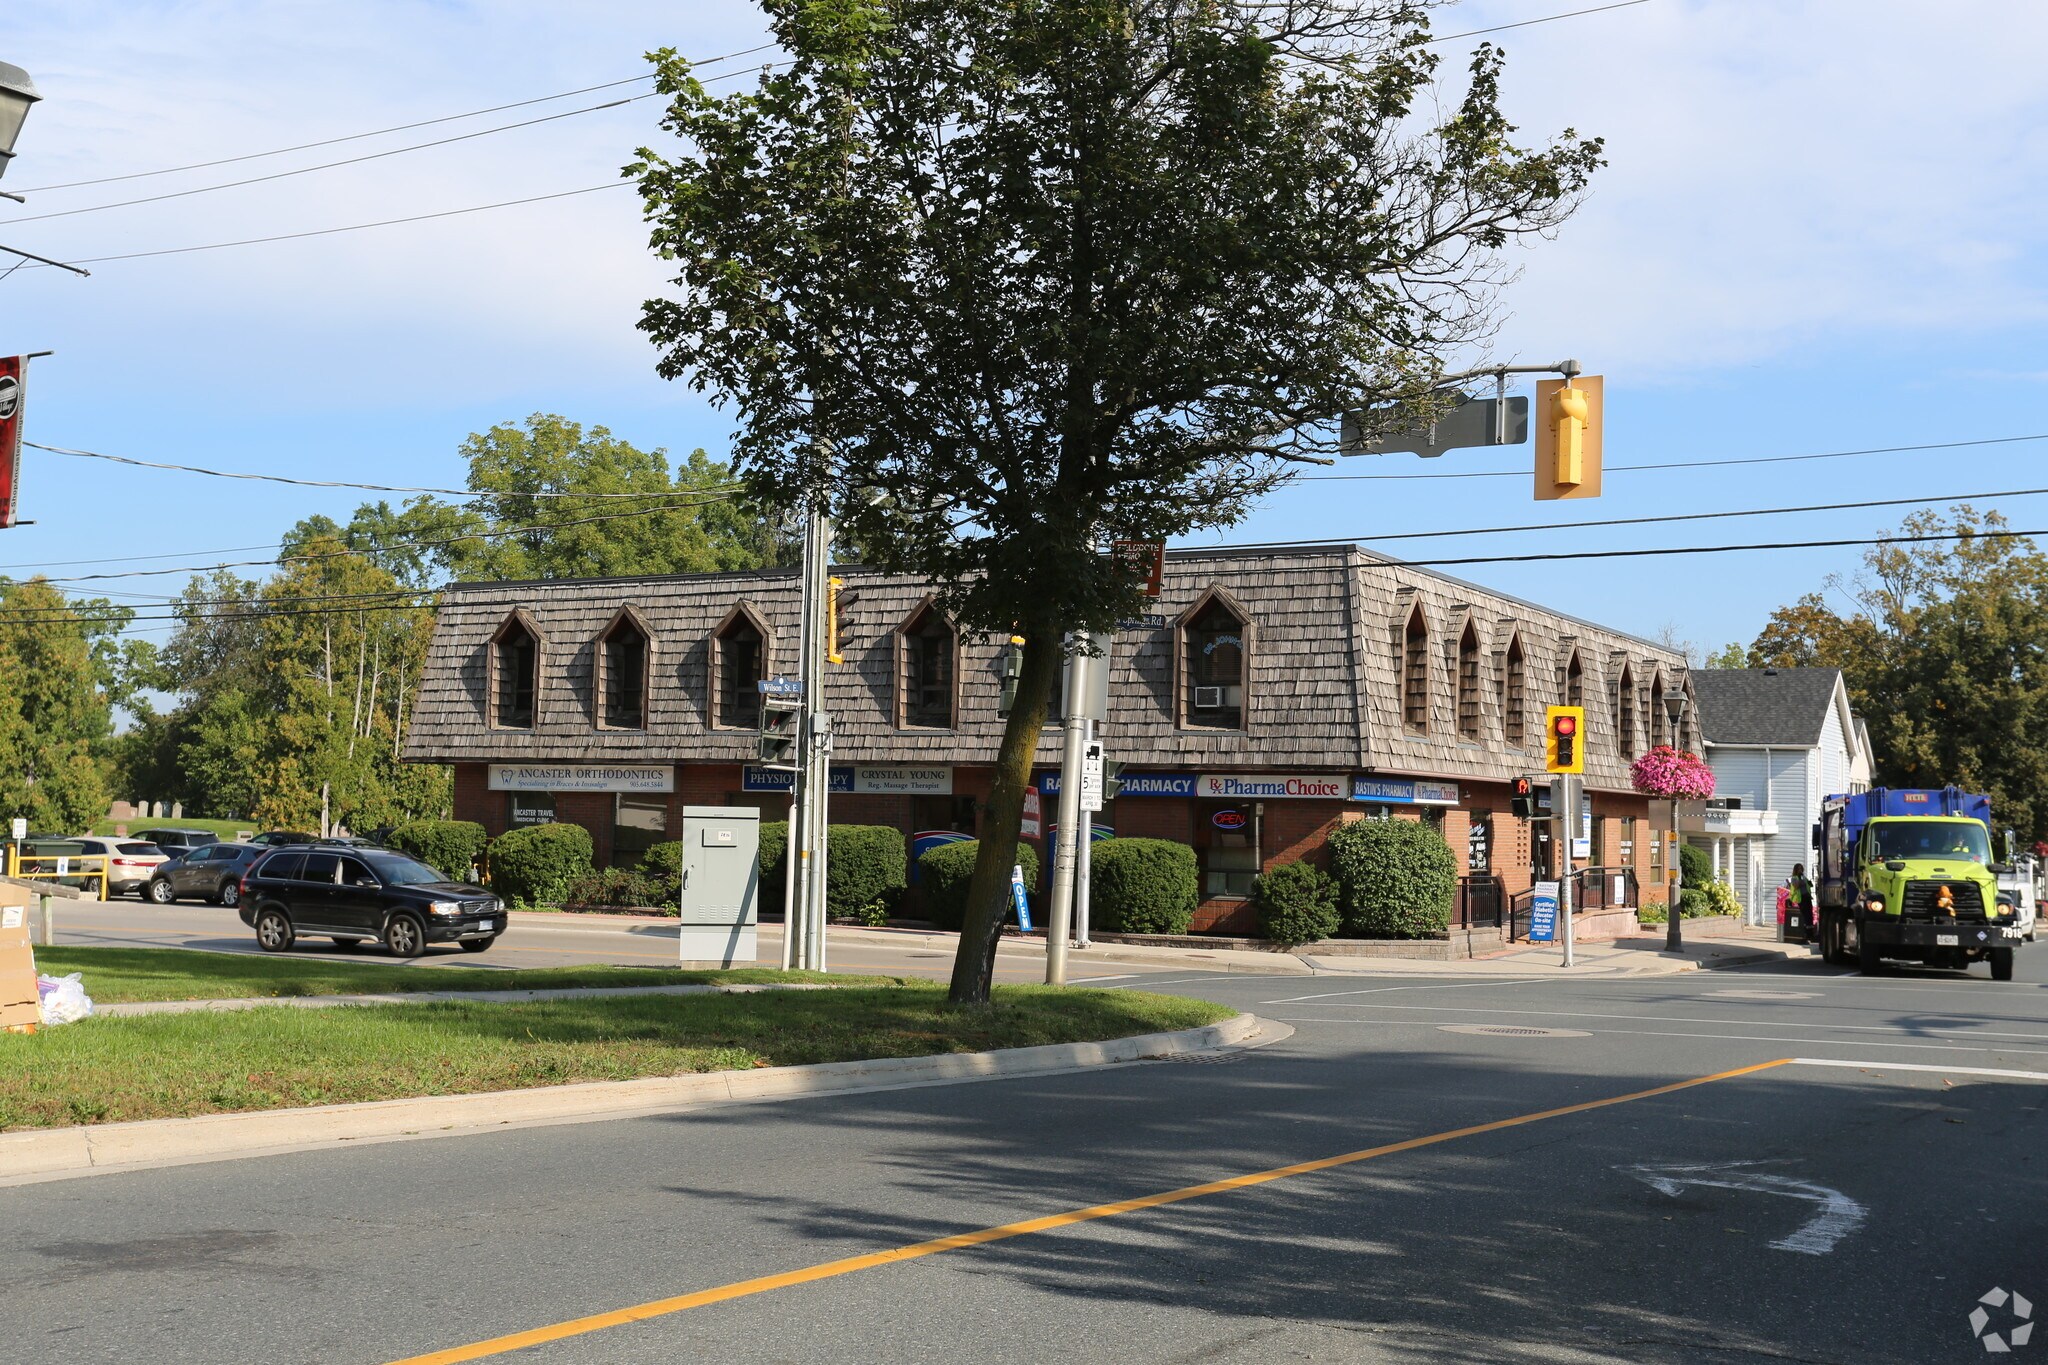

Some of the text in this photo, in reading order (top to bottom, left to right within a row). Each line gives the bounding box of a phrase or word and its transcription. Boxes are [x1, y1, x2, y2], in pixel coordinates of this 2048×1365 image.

[1151, 615, 1163, 626] Rd.
[763, 683, 782, 692] Wilson
[517, 768, 664, 780] ANCASTER ORTHODONTICS
[861, 770, 945, 780] CRYSTAL YOUNG
[517, 780, 548, 788] Specializing
[883, 782, 909, 790] Massage
[910, 782, 940, 790] Therapist
[1083, 776, 1089, 789] 5
[1121, 779, 1192, 793] HARMACY
[1223, 777, 1339, 796] PharmaChoice
[1355, 781, 1413, 798] RASTIN'S PHARMACY
[537, 809, 554, 817] TRAVEL
[1215, 813, 1246, 824] OPEN
[1015, 884, 1029, 929] OPEN
